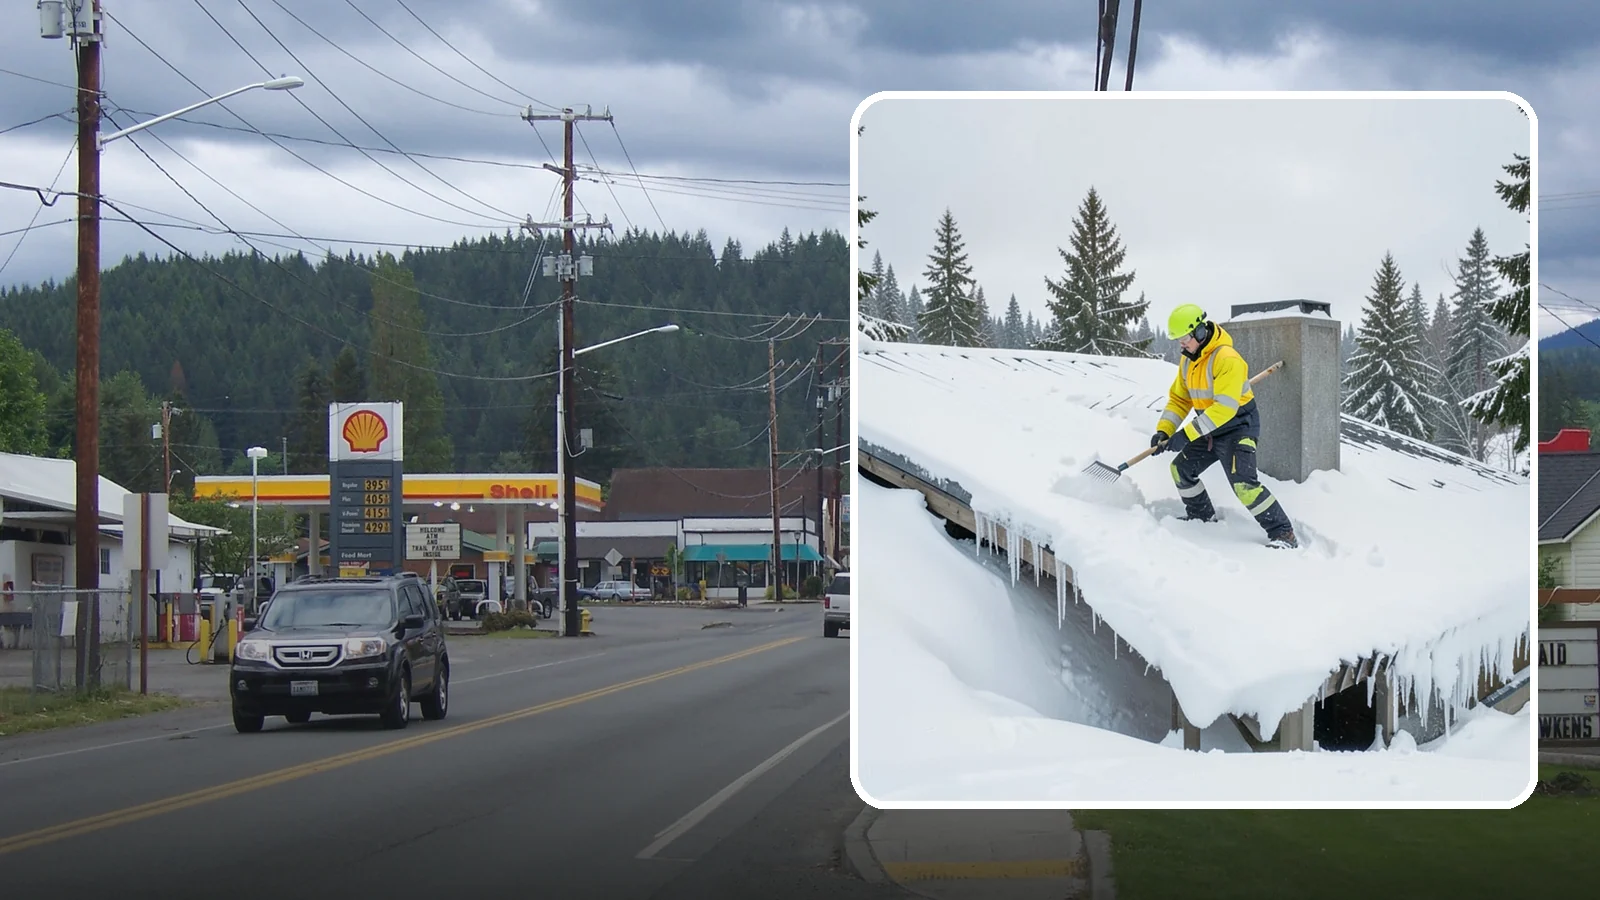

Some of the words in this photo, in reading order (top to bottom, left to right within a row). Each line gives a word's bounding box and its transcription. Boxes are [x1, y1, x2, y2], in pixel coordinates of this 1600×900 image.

[366, 480, 384, 490] 395
[490, 484, 547, 499] Shell
[366, 494, 384, 504] 405
[366, 508, 384, 518] 415
[366, 522, 384, 532] 429
